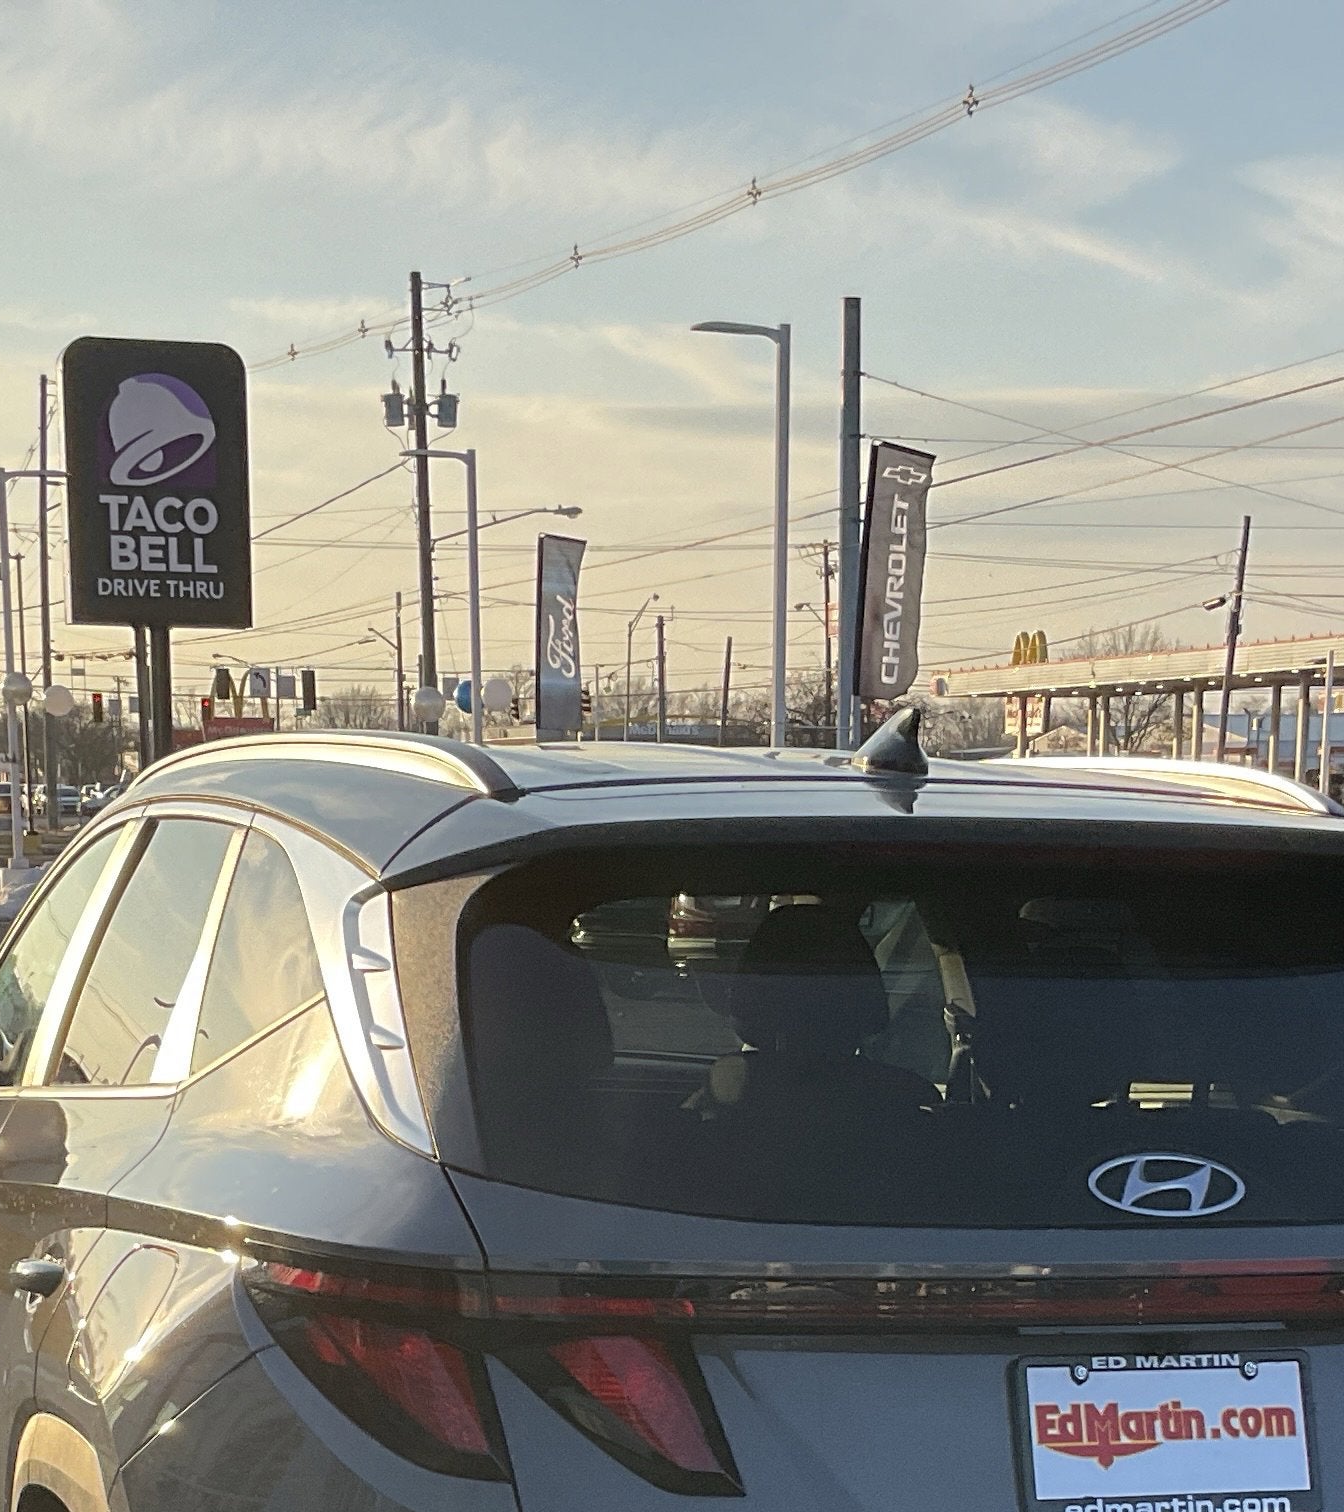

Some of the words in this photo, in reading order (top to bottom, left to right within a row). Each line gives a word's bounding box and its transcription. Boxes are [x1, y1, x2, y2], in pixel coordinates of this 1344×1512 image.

[99, 494, 219, 535] TACO
[110, 535, 218, 574] BELL
[97, 577, 161, 598] DRIVE
[166, 579, 225, 600] THRU
[880, 493, 910, 686] CHEVROLET
[547, 594, 576, 679] Ford
[1091, 1355, 1127, 1370] ED
[1135, 1353, 1241, 1369] MARTIN
[1034, 1400, 1298, 1446] EdMartin.com
